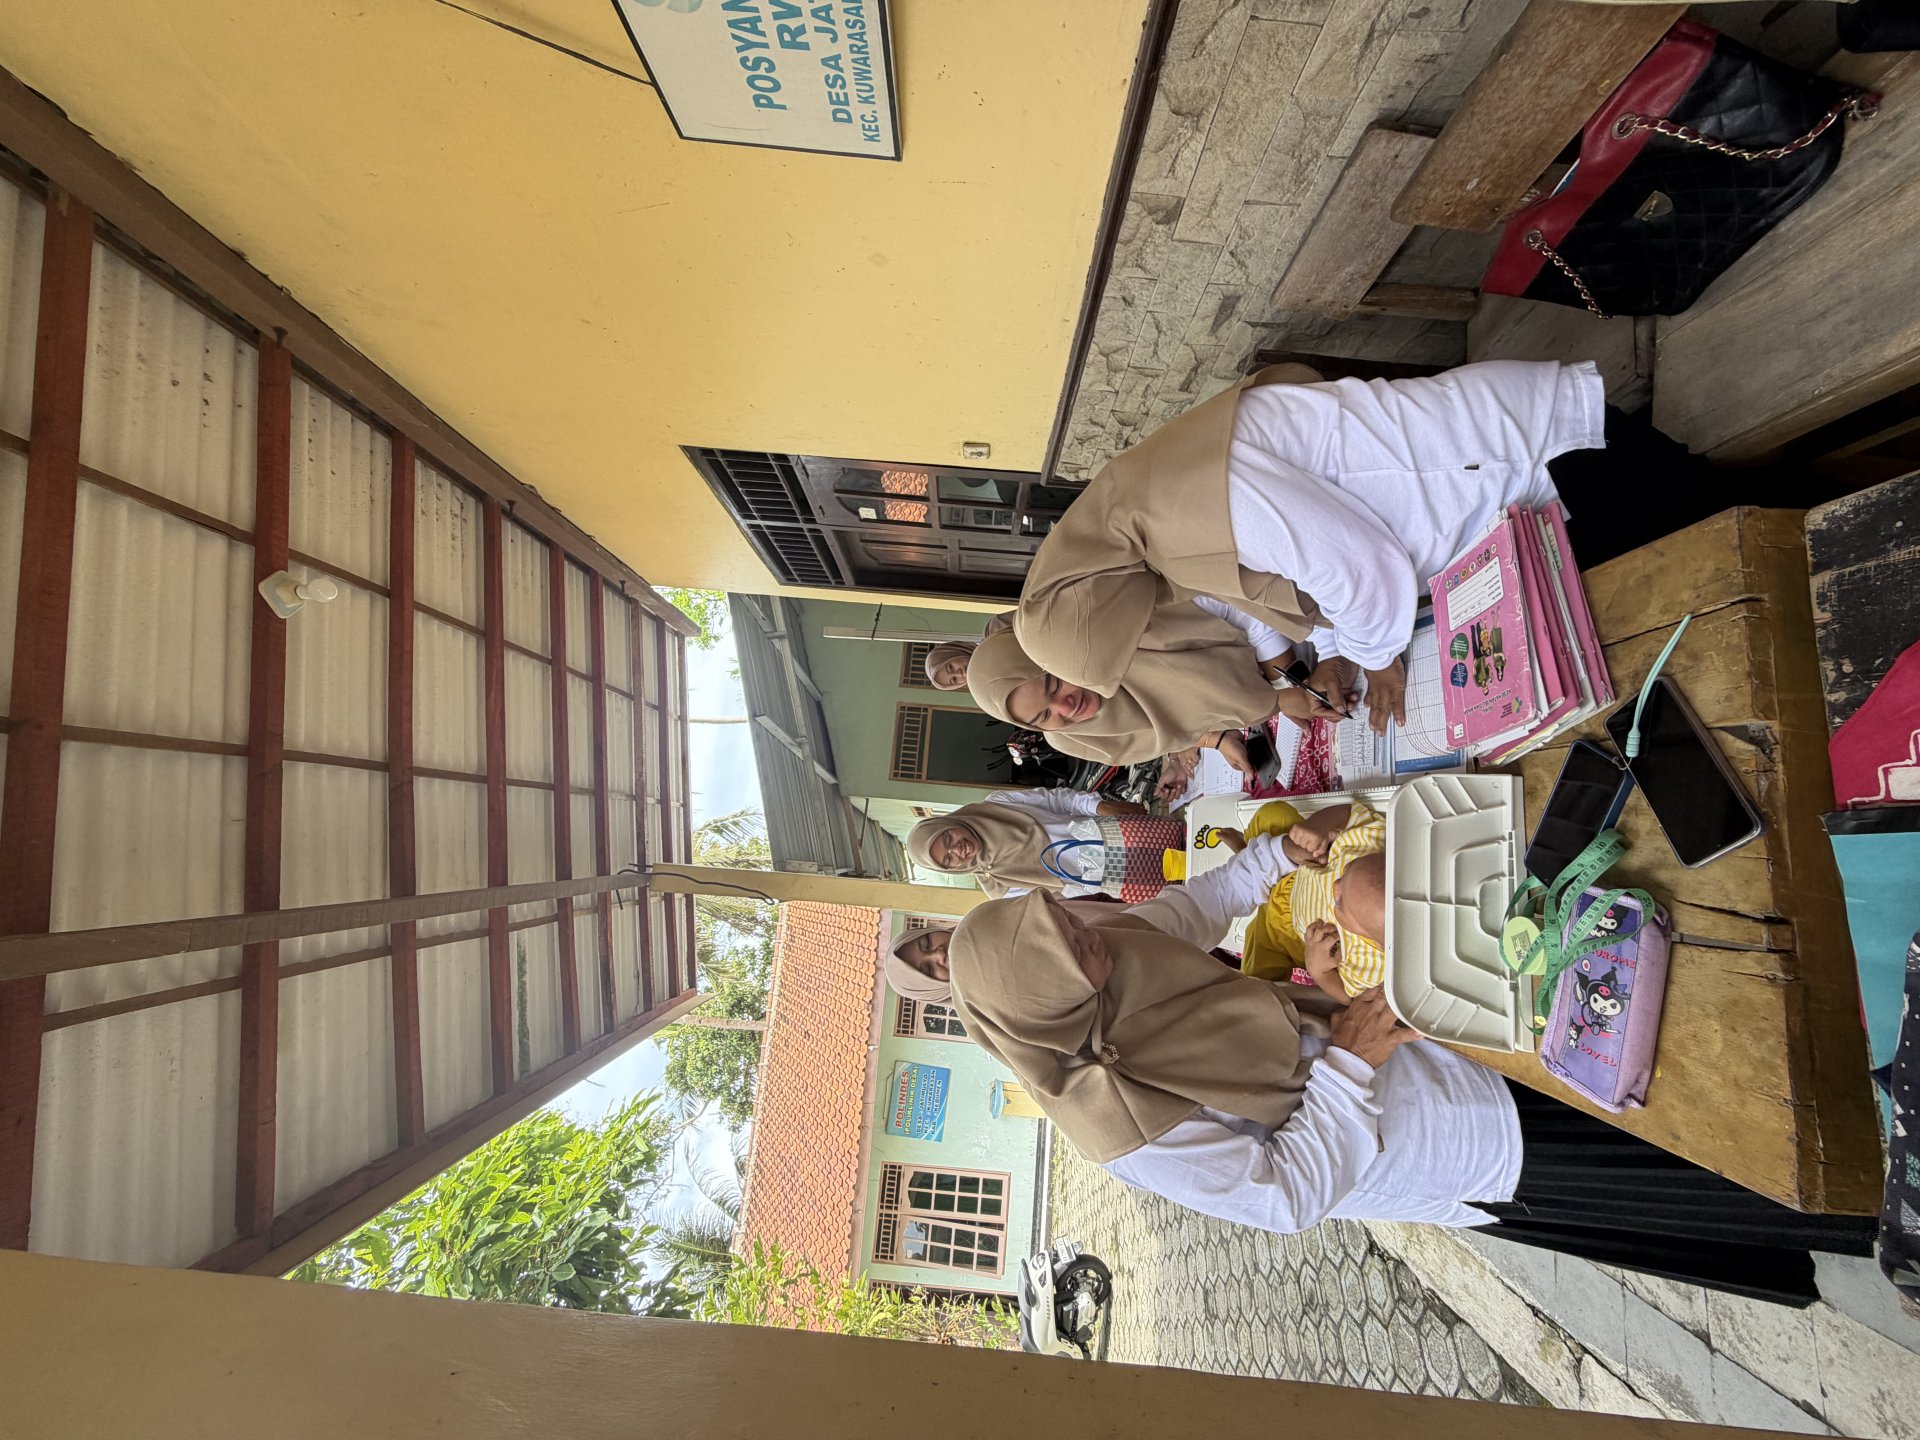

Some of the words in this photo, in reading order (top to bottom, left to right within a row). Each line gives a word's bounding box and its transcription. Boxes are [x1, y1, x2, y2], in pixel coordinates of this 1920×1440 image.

[808, 0, 838, 44] JA
[820, 53, 853, 124] DESA
[859, 109, 881, 143] KEC.
[1595, 841, 1607, 851] 10
[909, 1065, 919, 1088] DESA)
[895, 1071, 909, 1128] POLINDES
[904, 1090, 915, 1135] (POLIKLINIK
